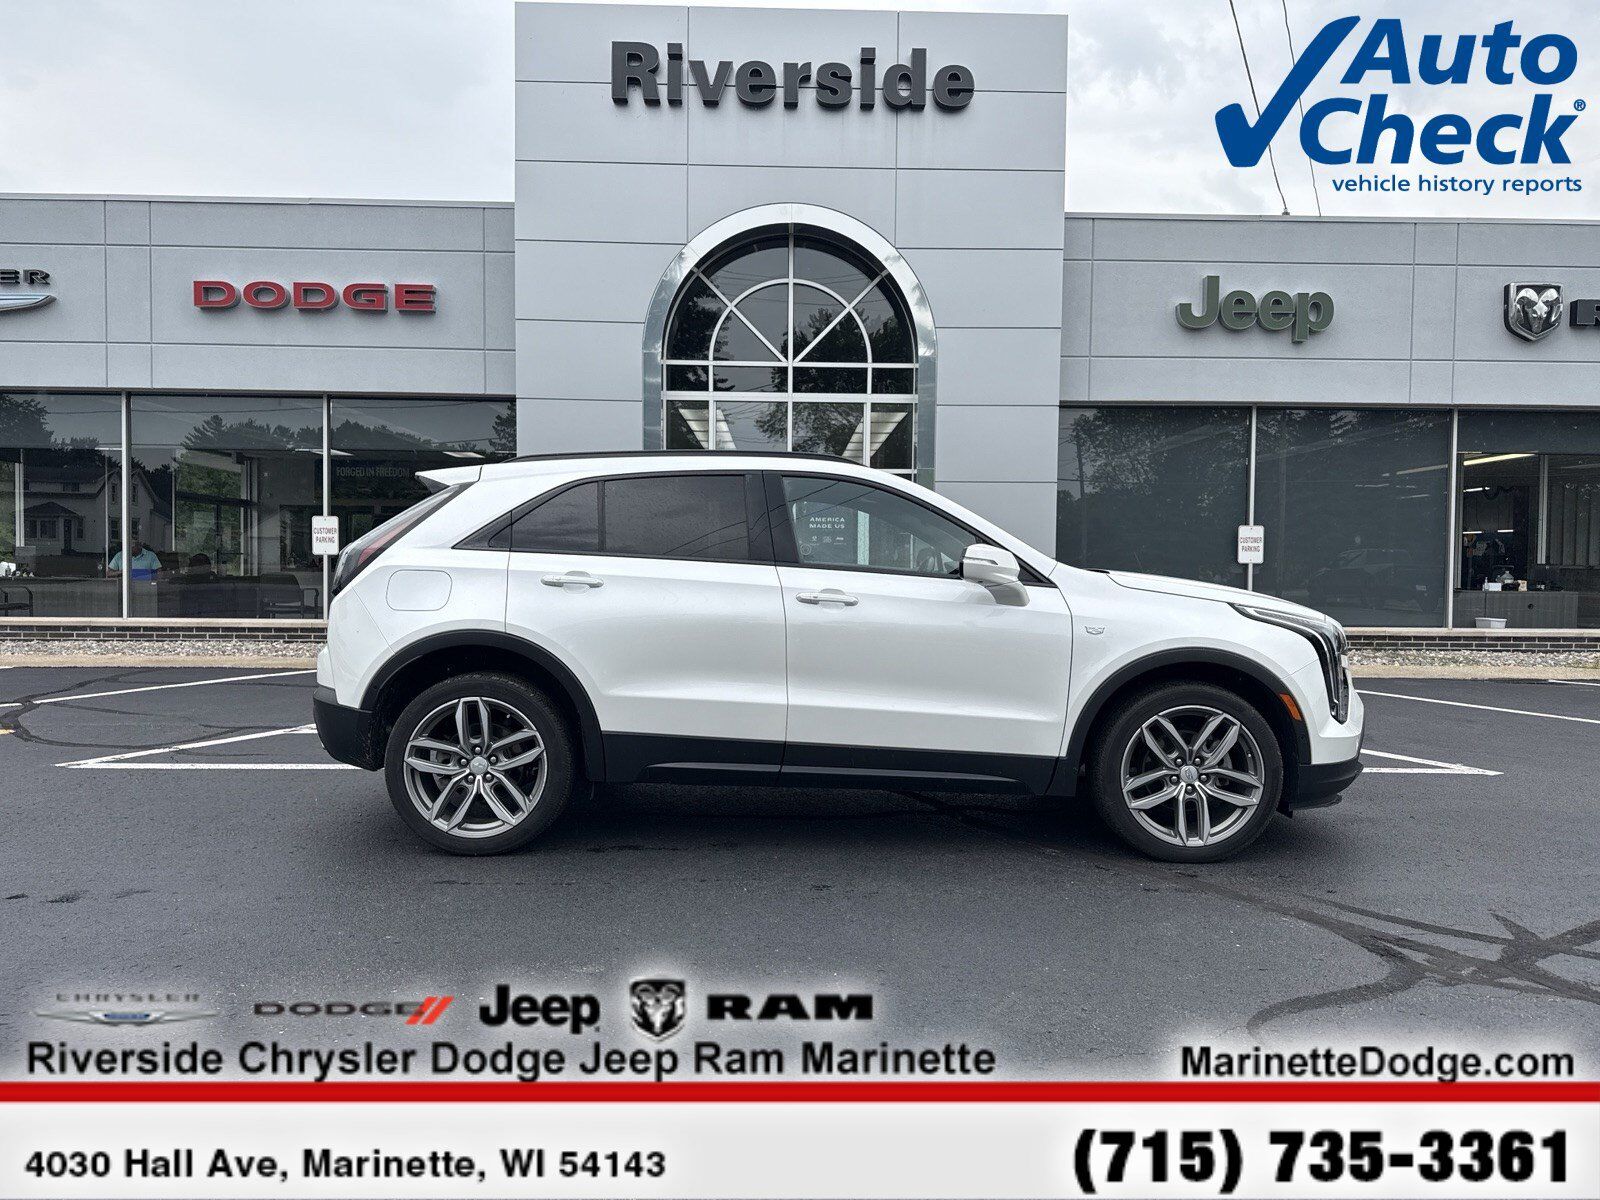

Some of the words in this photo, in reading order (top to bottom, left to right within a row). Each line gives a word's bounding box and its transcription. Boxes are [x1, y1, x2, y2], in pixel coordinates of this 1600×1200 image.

[611, 41, 974, 111] Riverside
[193, 280, 436, 316] DODGE
[1175, 275, 1335, 344] Jeep
[336, 466, 365, 477] FORGED
[366, 467, 375, 477] IN
